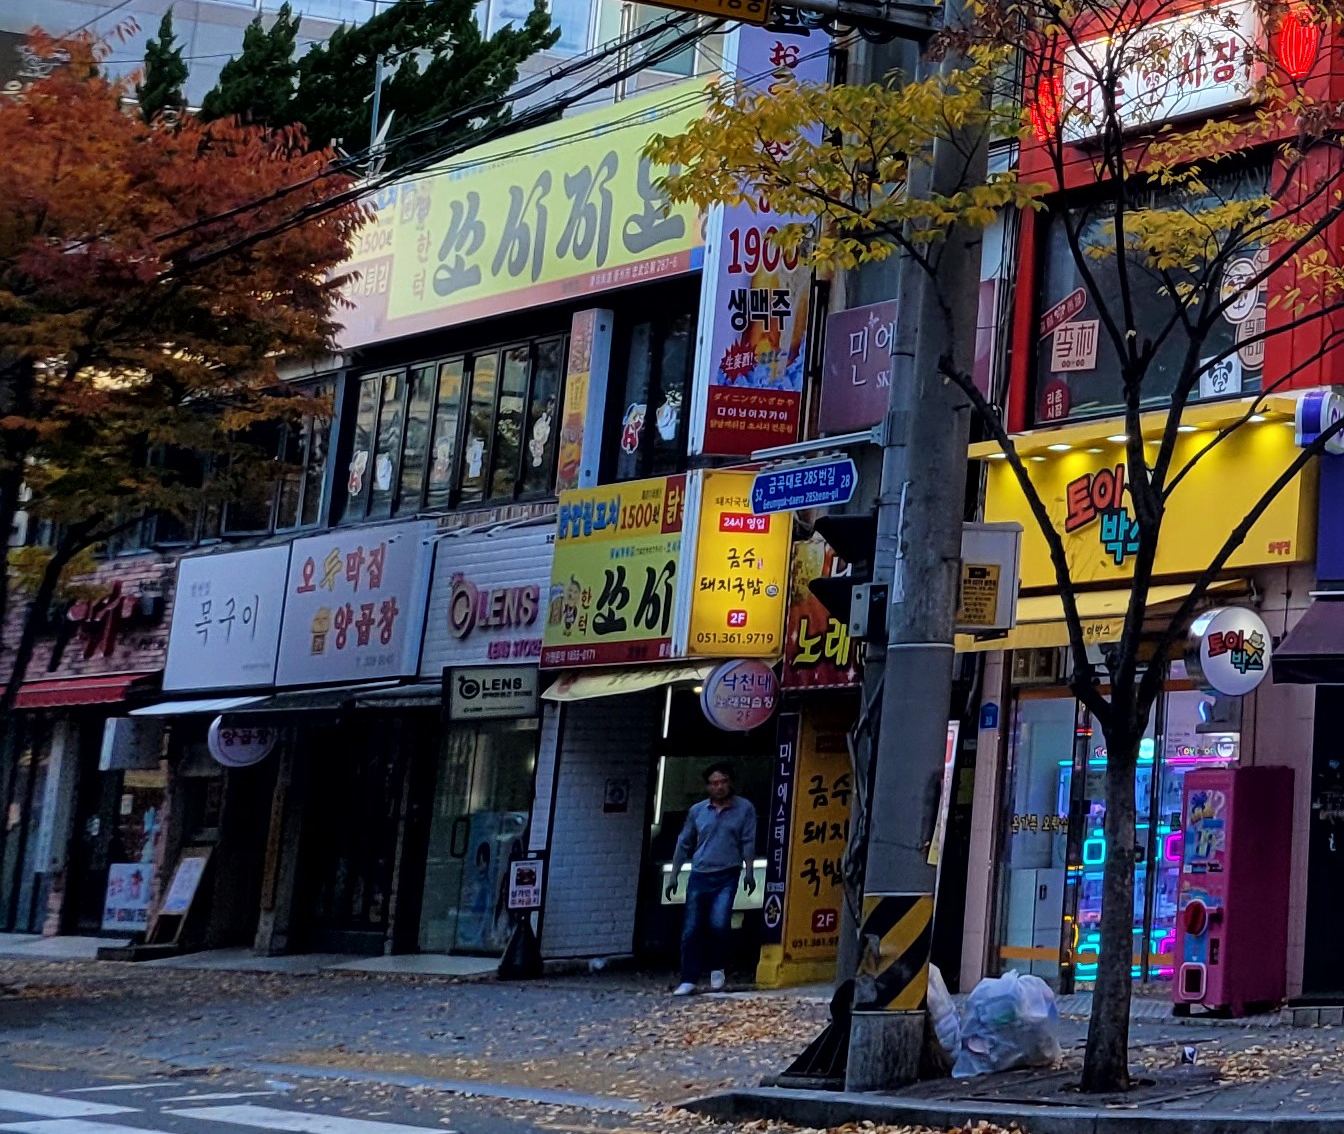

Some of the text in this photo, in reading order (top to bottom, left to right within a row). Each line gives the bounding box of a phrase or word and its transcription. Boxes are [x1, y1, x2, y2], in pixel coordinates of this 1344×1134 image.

[727, 287, 792, 332] 생맥주
[768, 466, 837, 495] 금곡대로 285번길
[840, 473, 851, 489] 28
[755, 488, 764, 502] 32
[1065, 462, 1126, 534] 토이
[723, 516, 766, 531] 24시 영업
[727, 547, 756, 570] 금수
[699, 576, 764, 602] 돼지국밥
[194, 593, 260, 647] 목구이
[333, 595, 399, 651] 양곱창
[729, 612, 746, 625] 2F
[696, 631, 774, 645] 051.361.9719
[1078, 624, 1112, 638] 이박스
[1207, 629, 1245, 658] 토이
[1231, 649, 1265, 674] 박스
[722, 672, 773, 692] 낙천대
[815, 913, 835, 928] 2F
